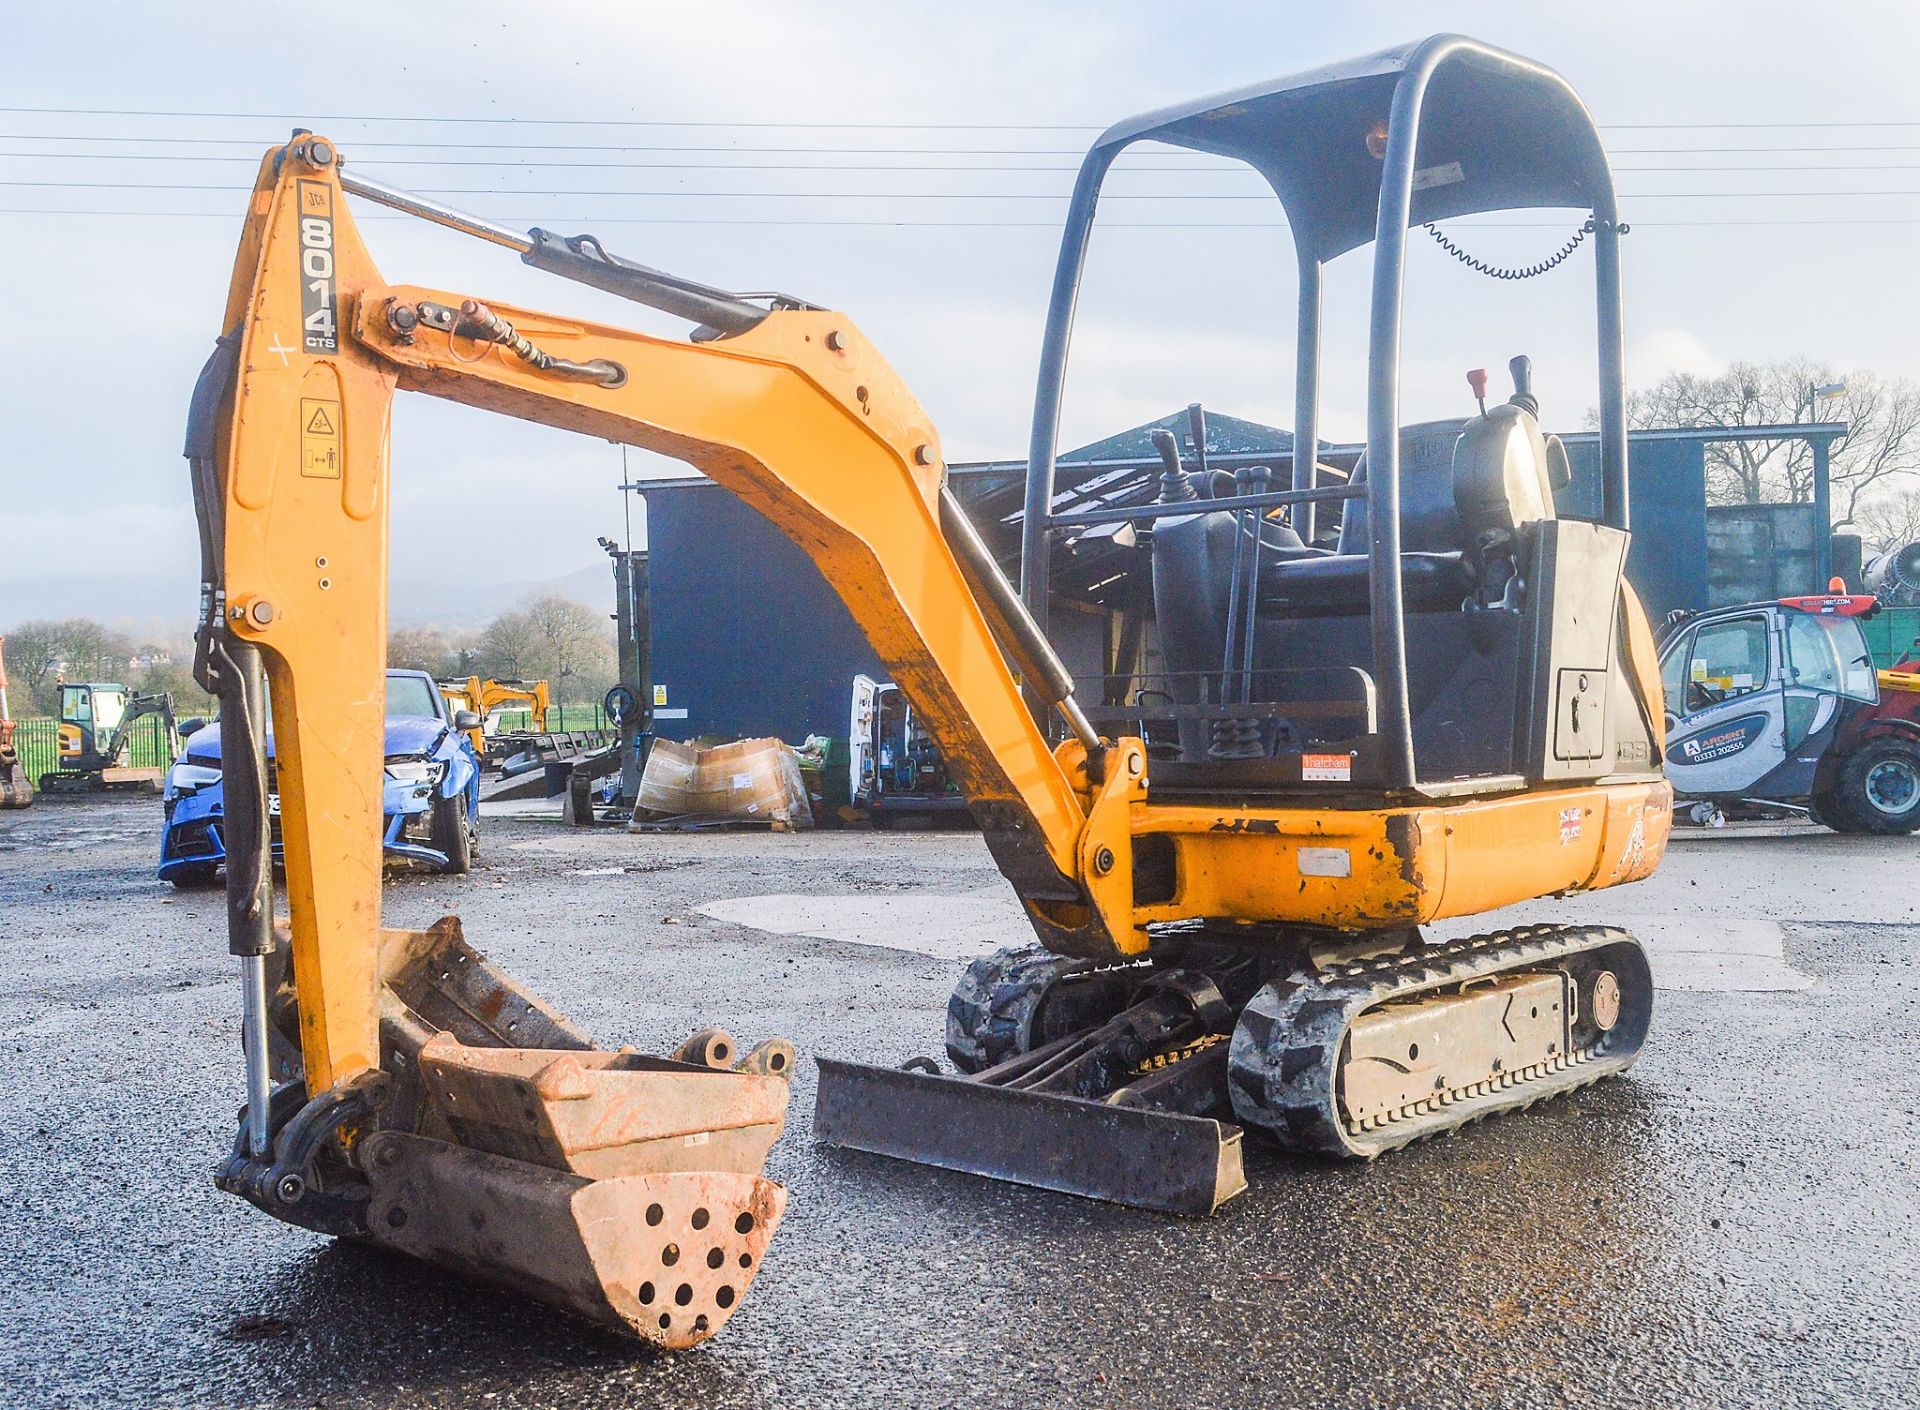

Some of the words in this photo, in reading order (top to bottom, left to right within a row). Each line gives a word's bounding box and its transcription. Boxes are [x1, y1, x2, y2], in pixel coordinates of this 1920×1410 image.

[302, 218, 336, 337] 8014
[306, 336, 336, 349] CTS
[1702, 727, 1745, 748] ARDENT
[1304, 755, 1349, 768] Thatcham
[1694, 750, 1717, 762] 03333
[1717, 741, 1745, 756] 202555
